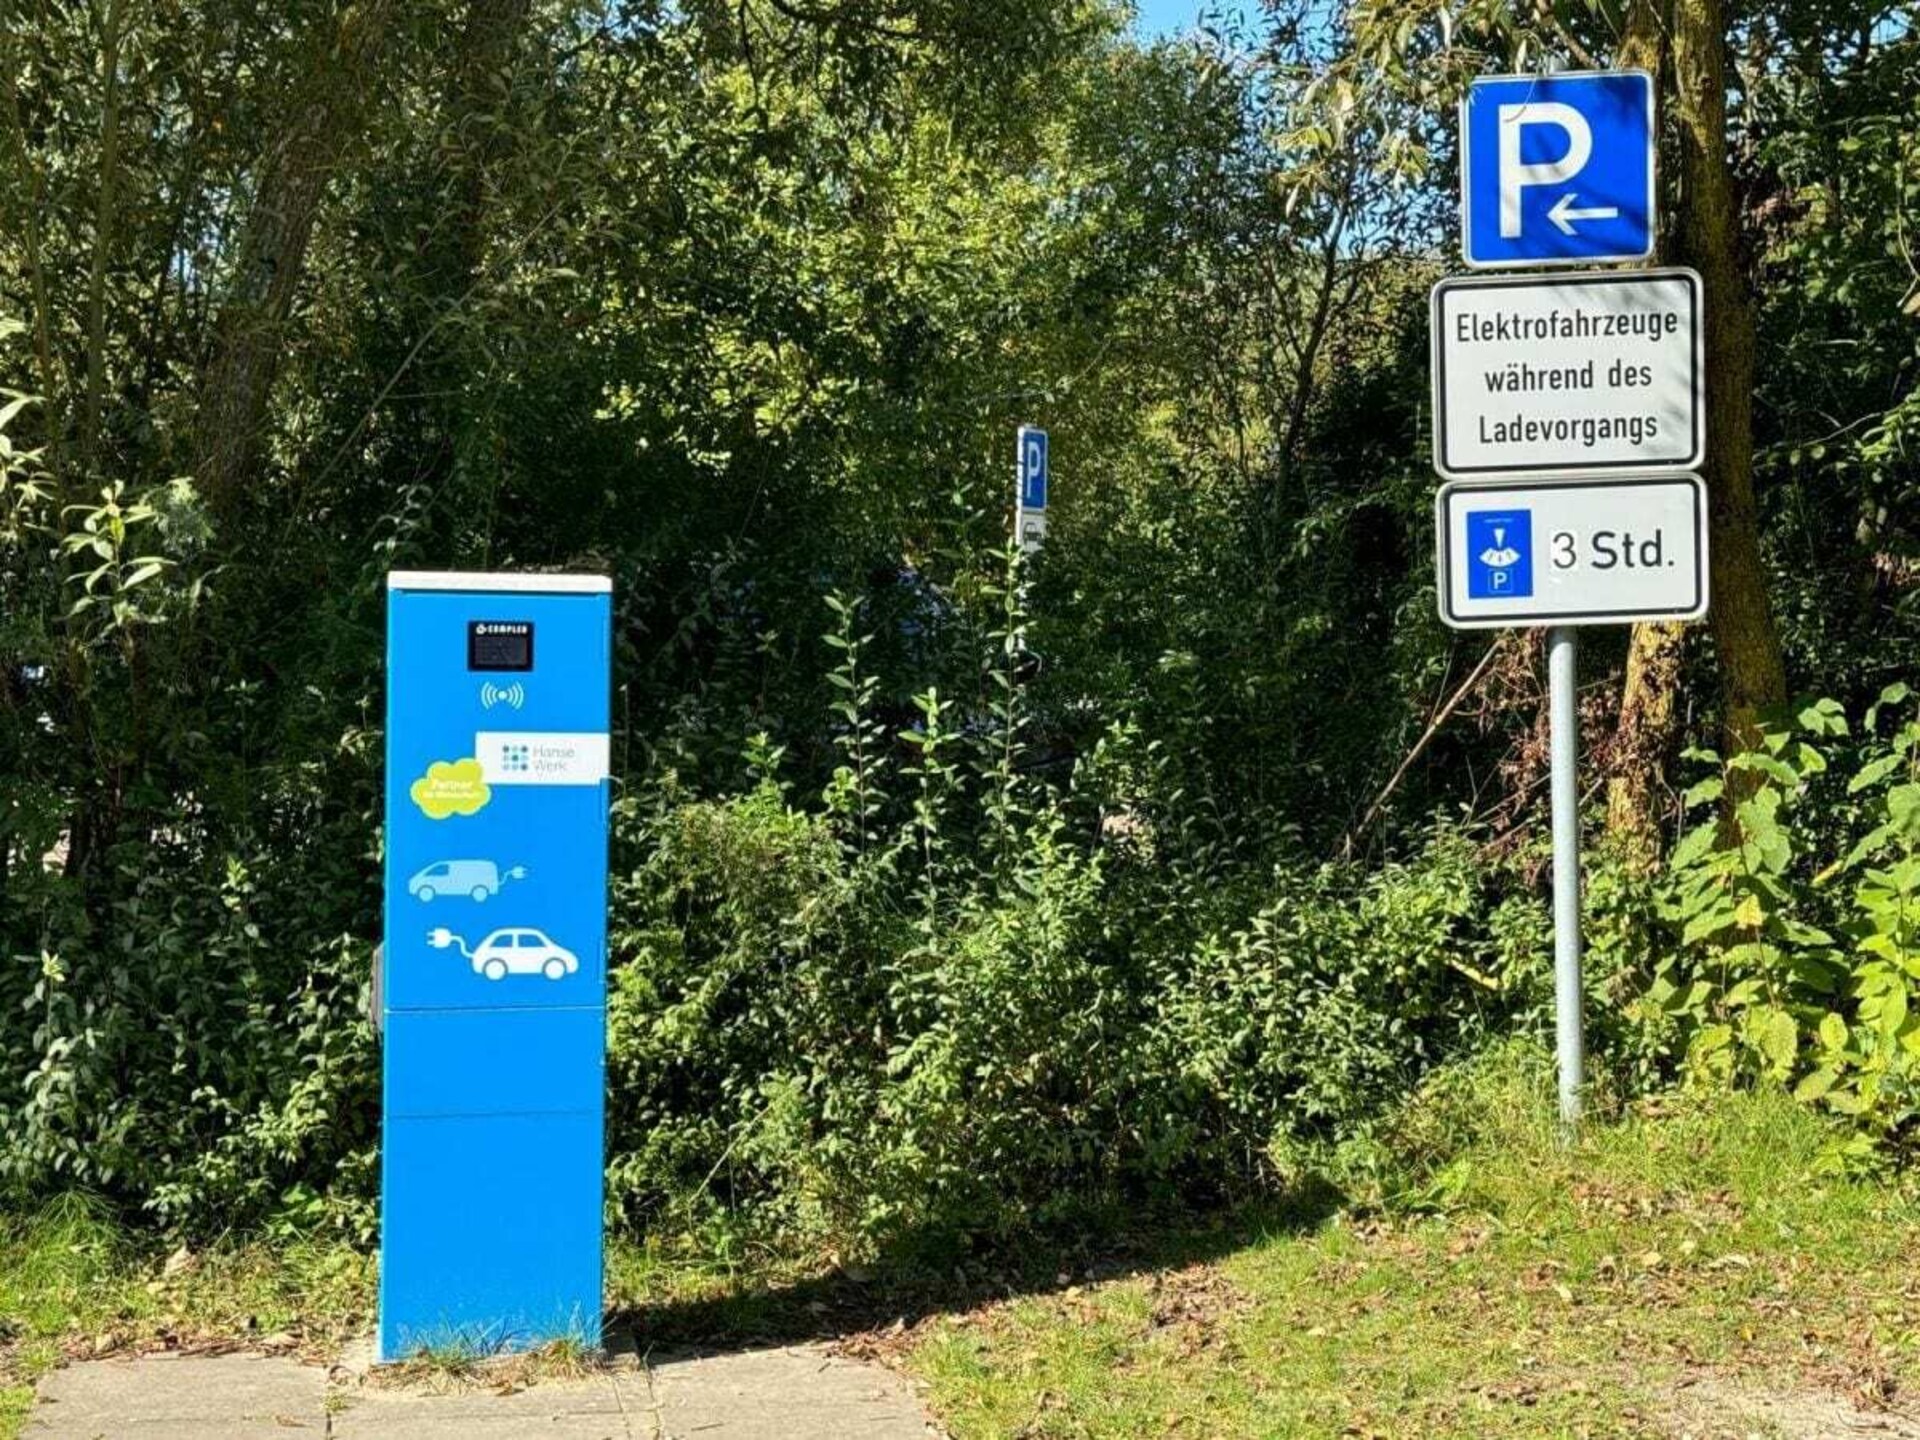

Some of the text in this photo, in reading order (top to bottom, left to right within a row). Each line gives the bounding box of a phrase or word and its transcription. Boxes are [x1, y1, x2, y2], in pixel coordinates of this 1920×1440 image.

[1498, 101, 1593, 238] P
[1456, 308, 1679, 342] Elektrofahrzeuge
[1484, 358, 1652, 393] während des
[1479, 413, 1658, 447] Ladevorgangs
[1027, 440, 1041, 498] P
[1552, 529, 1675, 570] 3 Std.
[1493, 572, 1508, 590] P
[533, 746, 575, 758] Hanse
[534, 760, 568, 771] Werk
